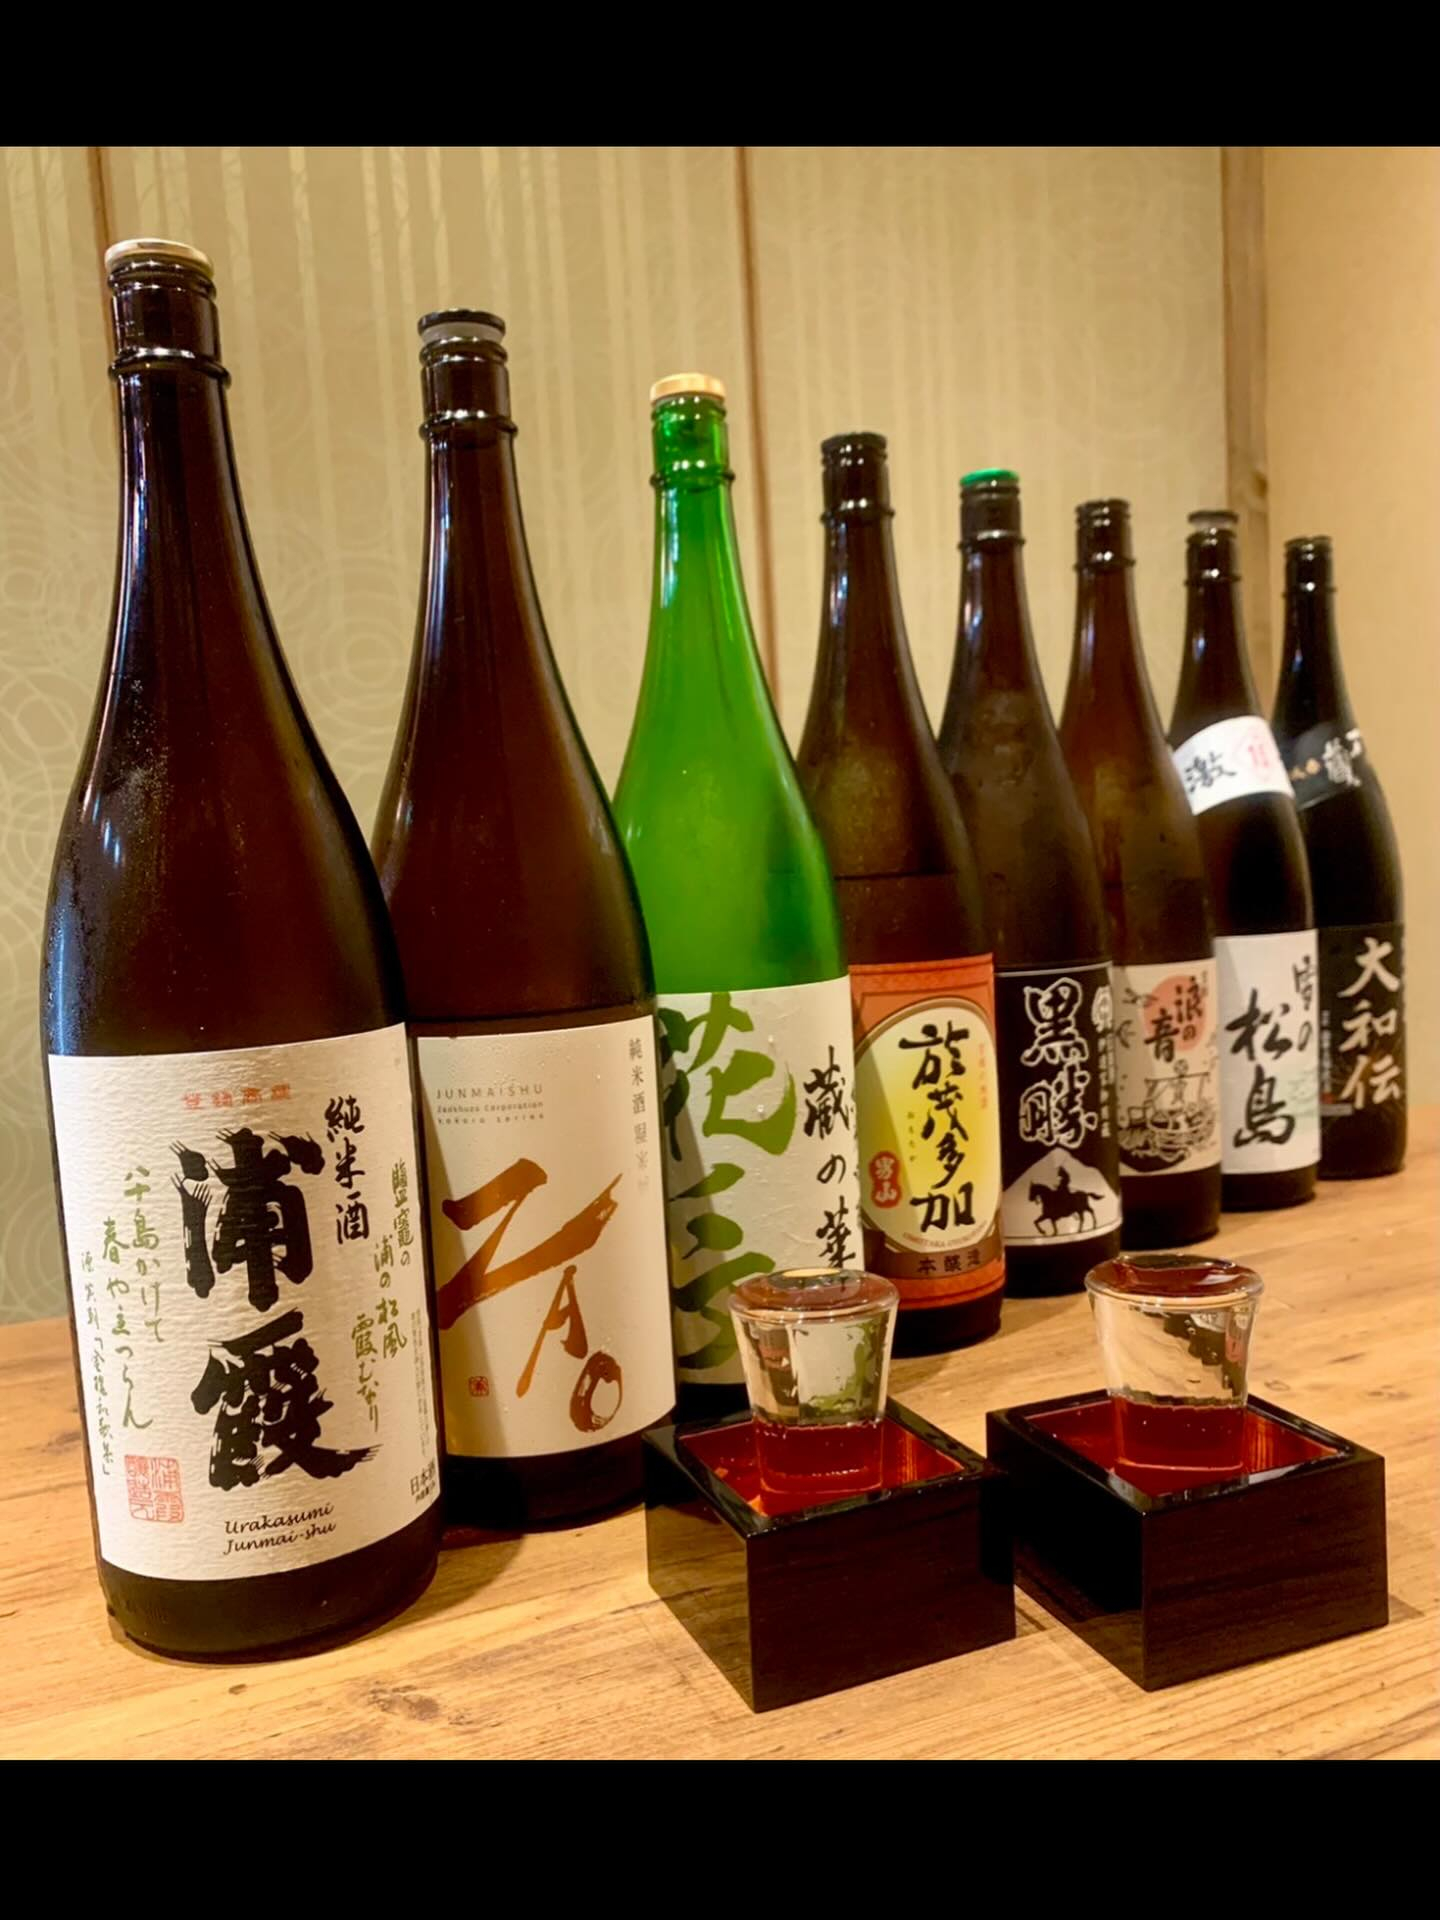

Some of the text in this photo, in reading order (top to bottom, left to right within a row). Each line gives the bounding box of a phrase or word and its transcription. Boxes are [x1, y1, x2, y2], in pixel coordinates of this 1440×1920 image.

[436, 1083, 543, 1100] JUNMAISHU
[1225, 987, 1296, 1149] 松島
[1337, 936, 1401, 1110] 大和伝
[324, 1095, 370, 1245] 純米酒
[898, 1020, 976, 1233] 於茂多加
[168, 1127, 384, 1492] 浦霞
[437, 1157, 623, 1433] ZAO
[222, 1520, 337, 1556] Junmai-shu
[225, 1501, 336, 1535] Urakasumi
